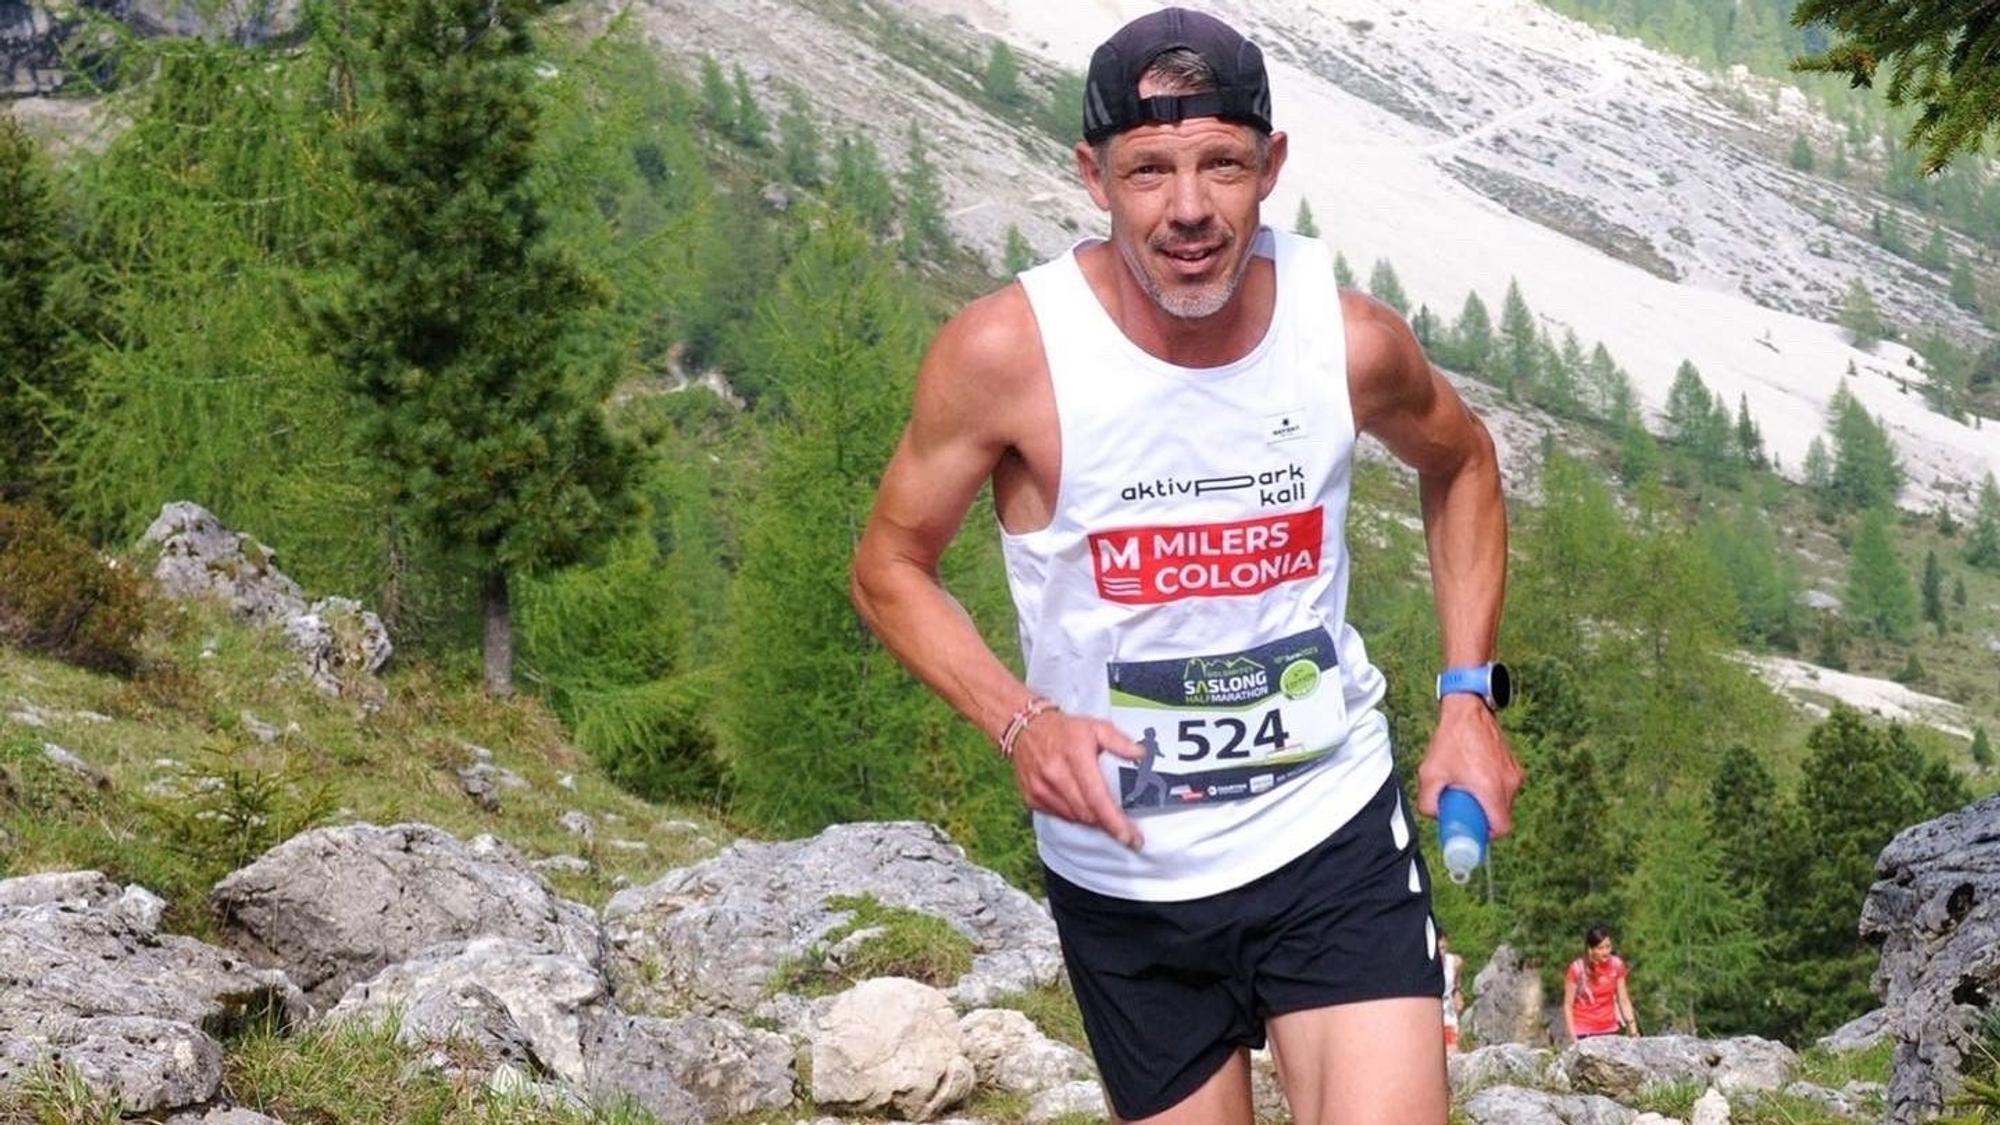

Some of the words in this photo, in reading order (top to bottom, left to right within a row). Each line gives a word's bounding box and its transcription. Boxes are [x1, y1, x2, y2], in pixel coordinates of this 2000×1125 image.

[1260, 482, 1305, 507] kall
[1153, 522, 1290, 560] MILERS
[1155, 549, 1314, 594] COLONIA
[1184, 670, 1267, 695] SASLONG
[1178, 708, 1289, 761] 524
